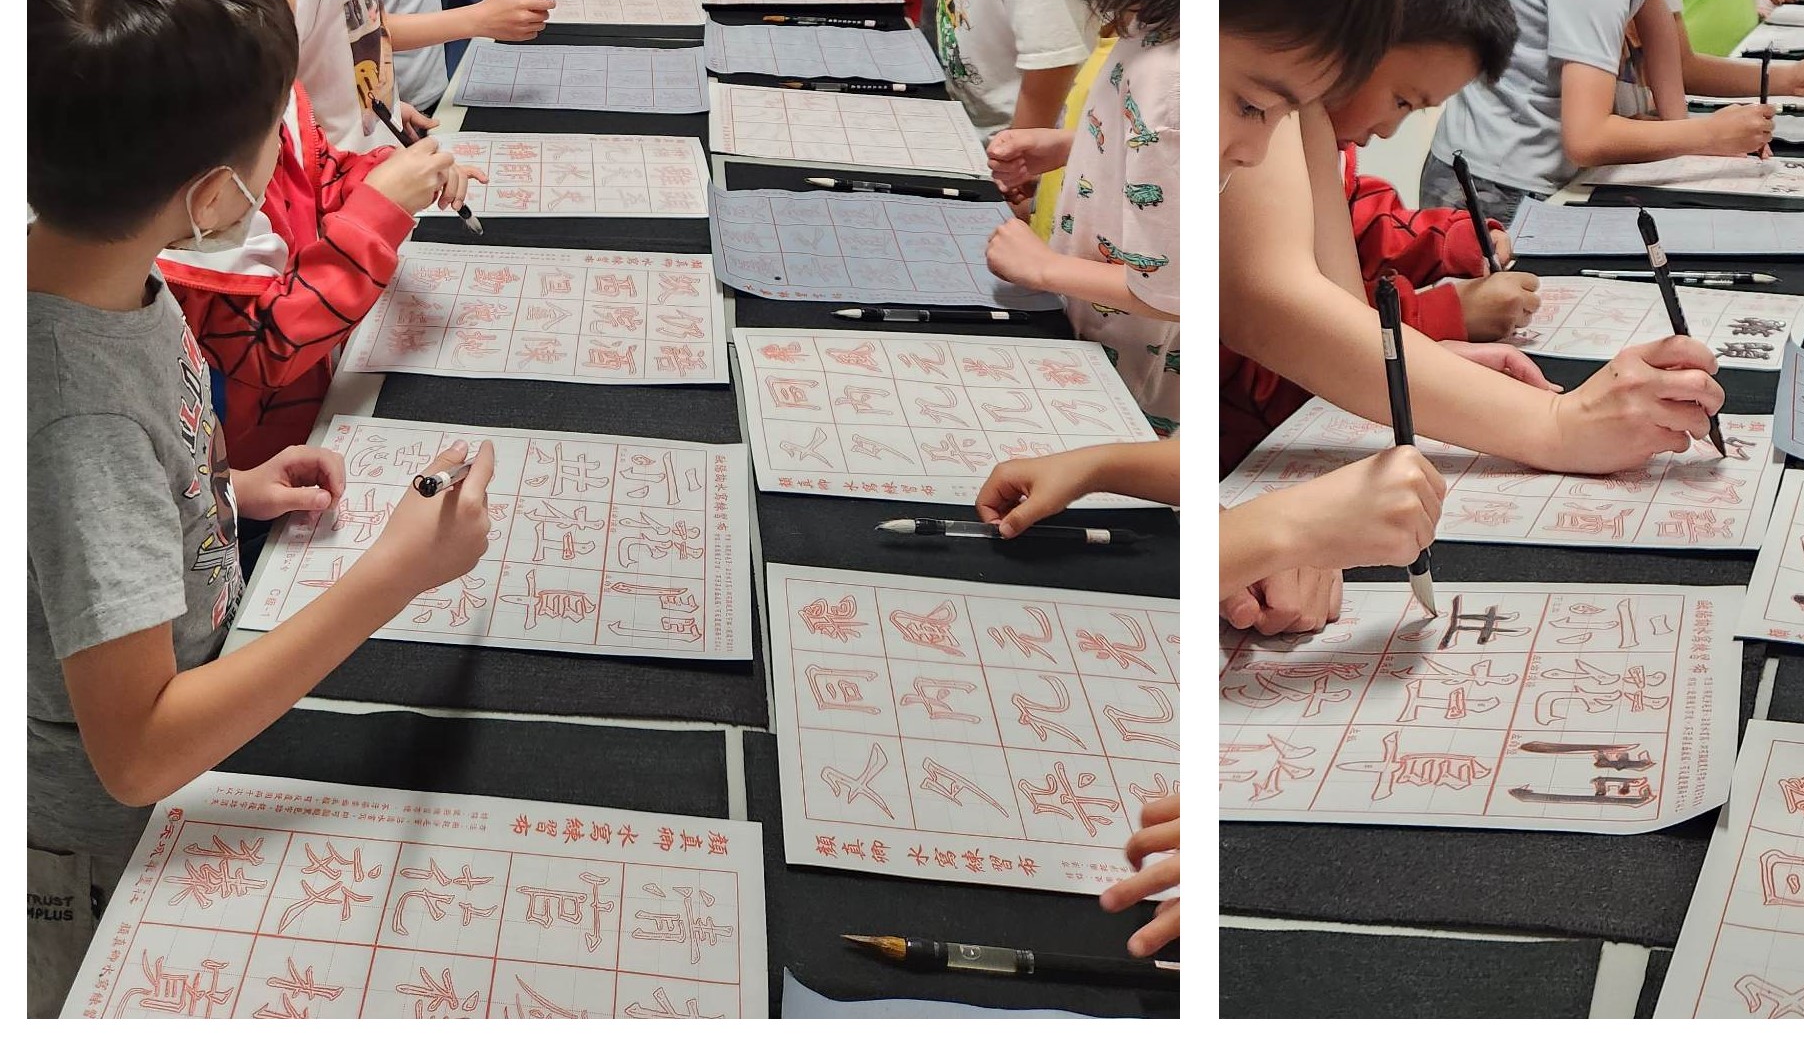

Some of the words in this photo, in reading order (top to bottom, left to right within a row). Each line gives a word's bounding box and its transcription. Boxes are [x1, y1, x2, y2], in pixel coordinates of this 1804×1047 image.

[508, 812, 640, 849] 水寫練習布
[653, 826, 730, 857] 顏真卿
[814, 833, 892, 865] 顏真卿
[906, 846, 1042, 878] 水寫練習布
